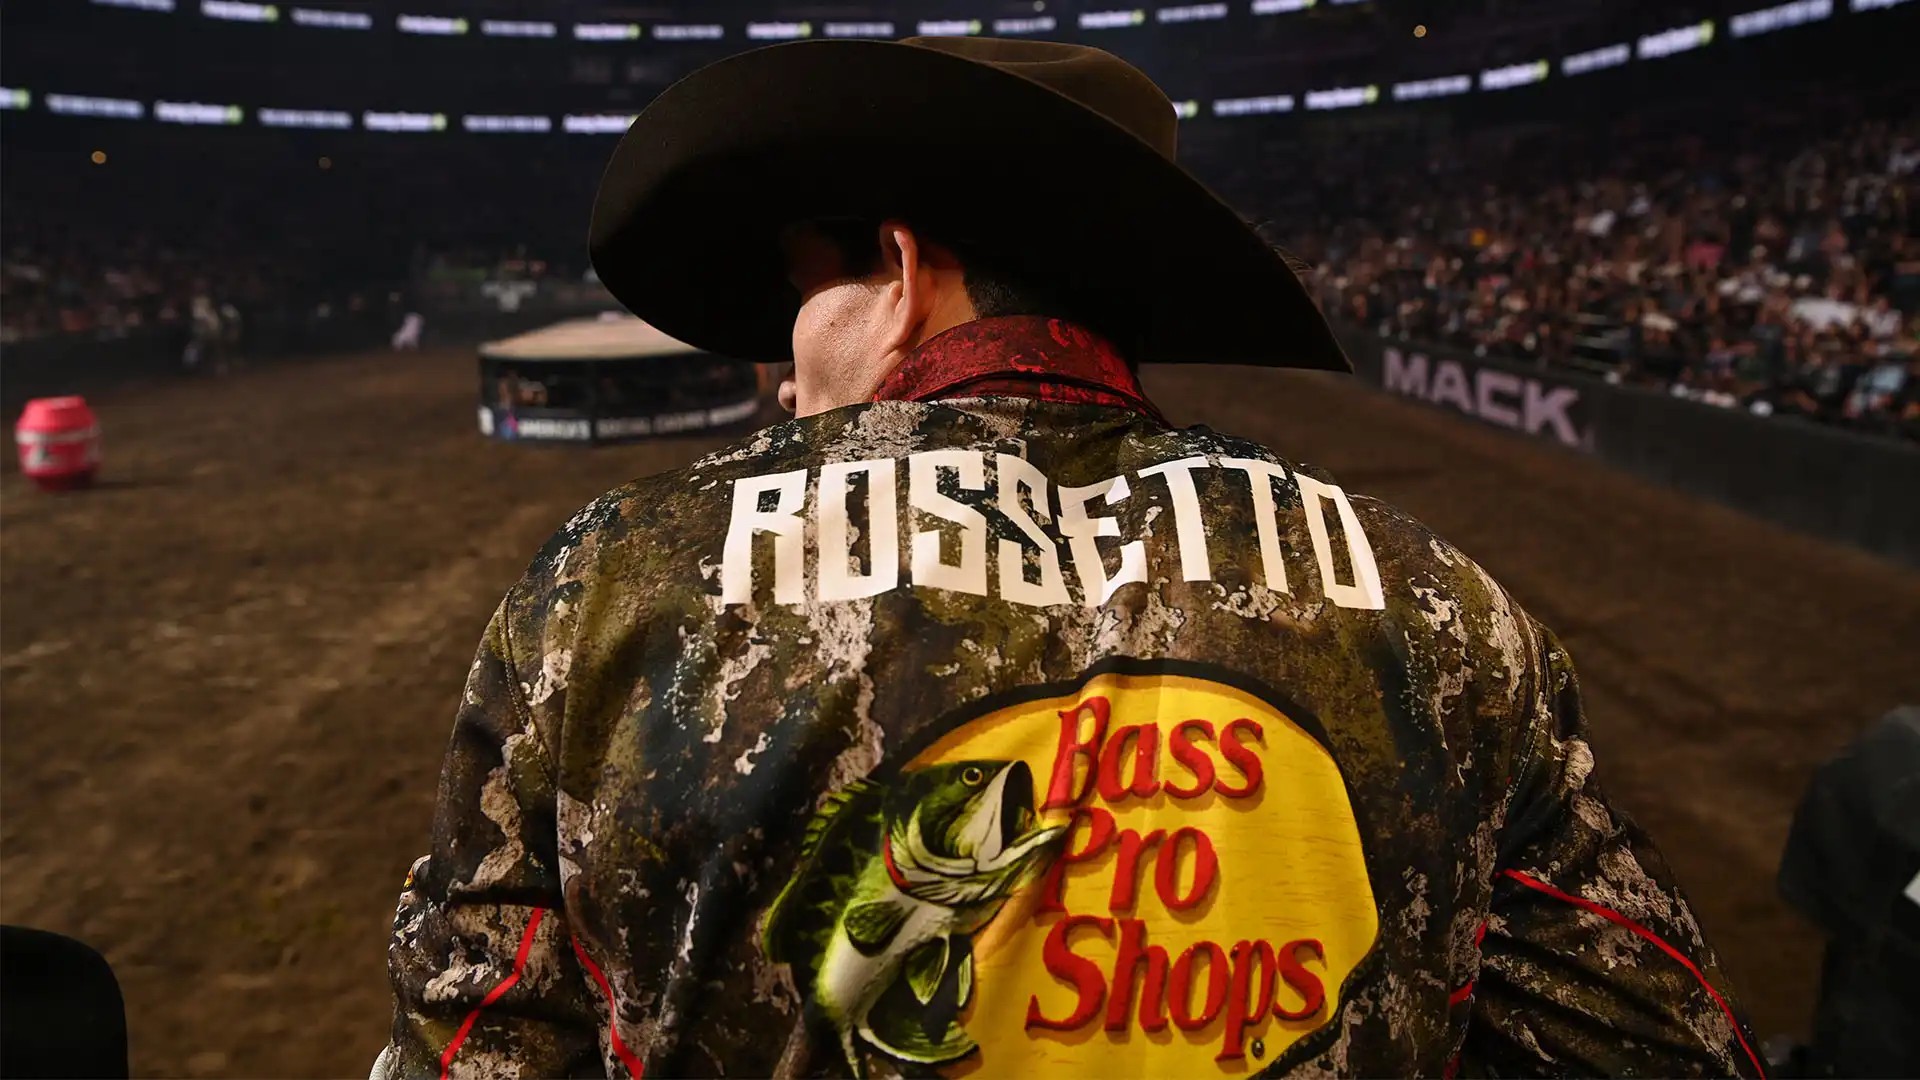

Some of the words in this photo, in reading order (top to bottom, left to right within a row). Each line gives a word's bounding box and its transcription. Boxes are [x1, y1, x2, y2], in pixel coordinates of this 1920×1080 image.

[1383, 349, 1580, 447] MACK
[722, 450, 1385, 610] ROSSETTO
[1040, 696, 1264, 813] Bass
[1034, 806, 1218, 914] Pro
[1024, 914, 1326, 1062] Shops
